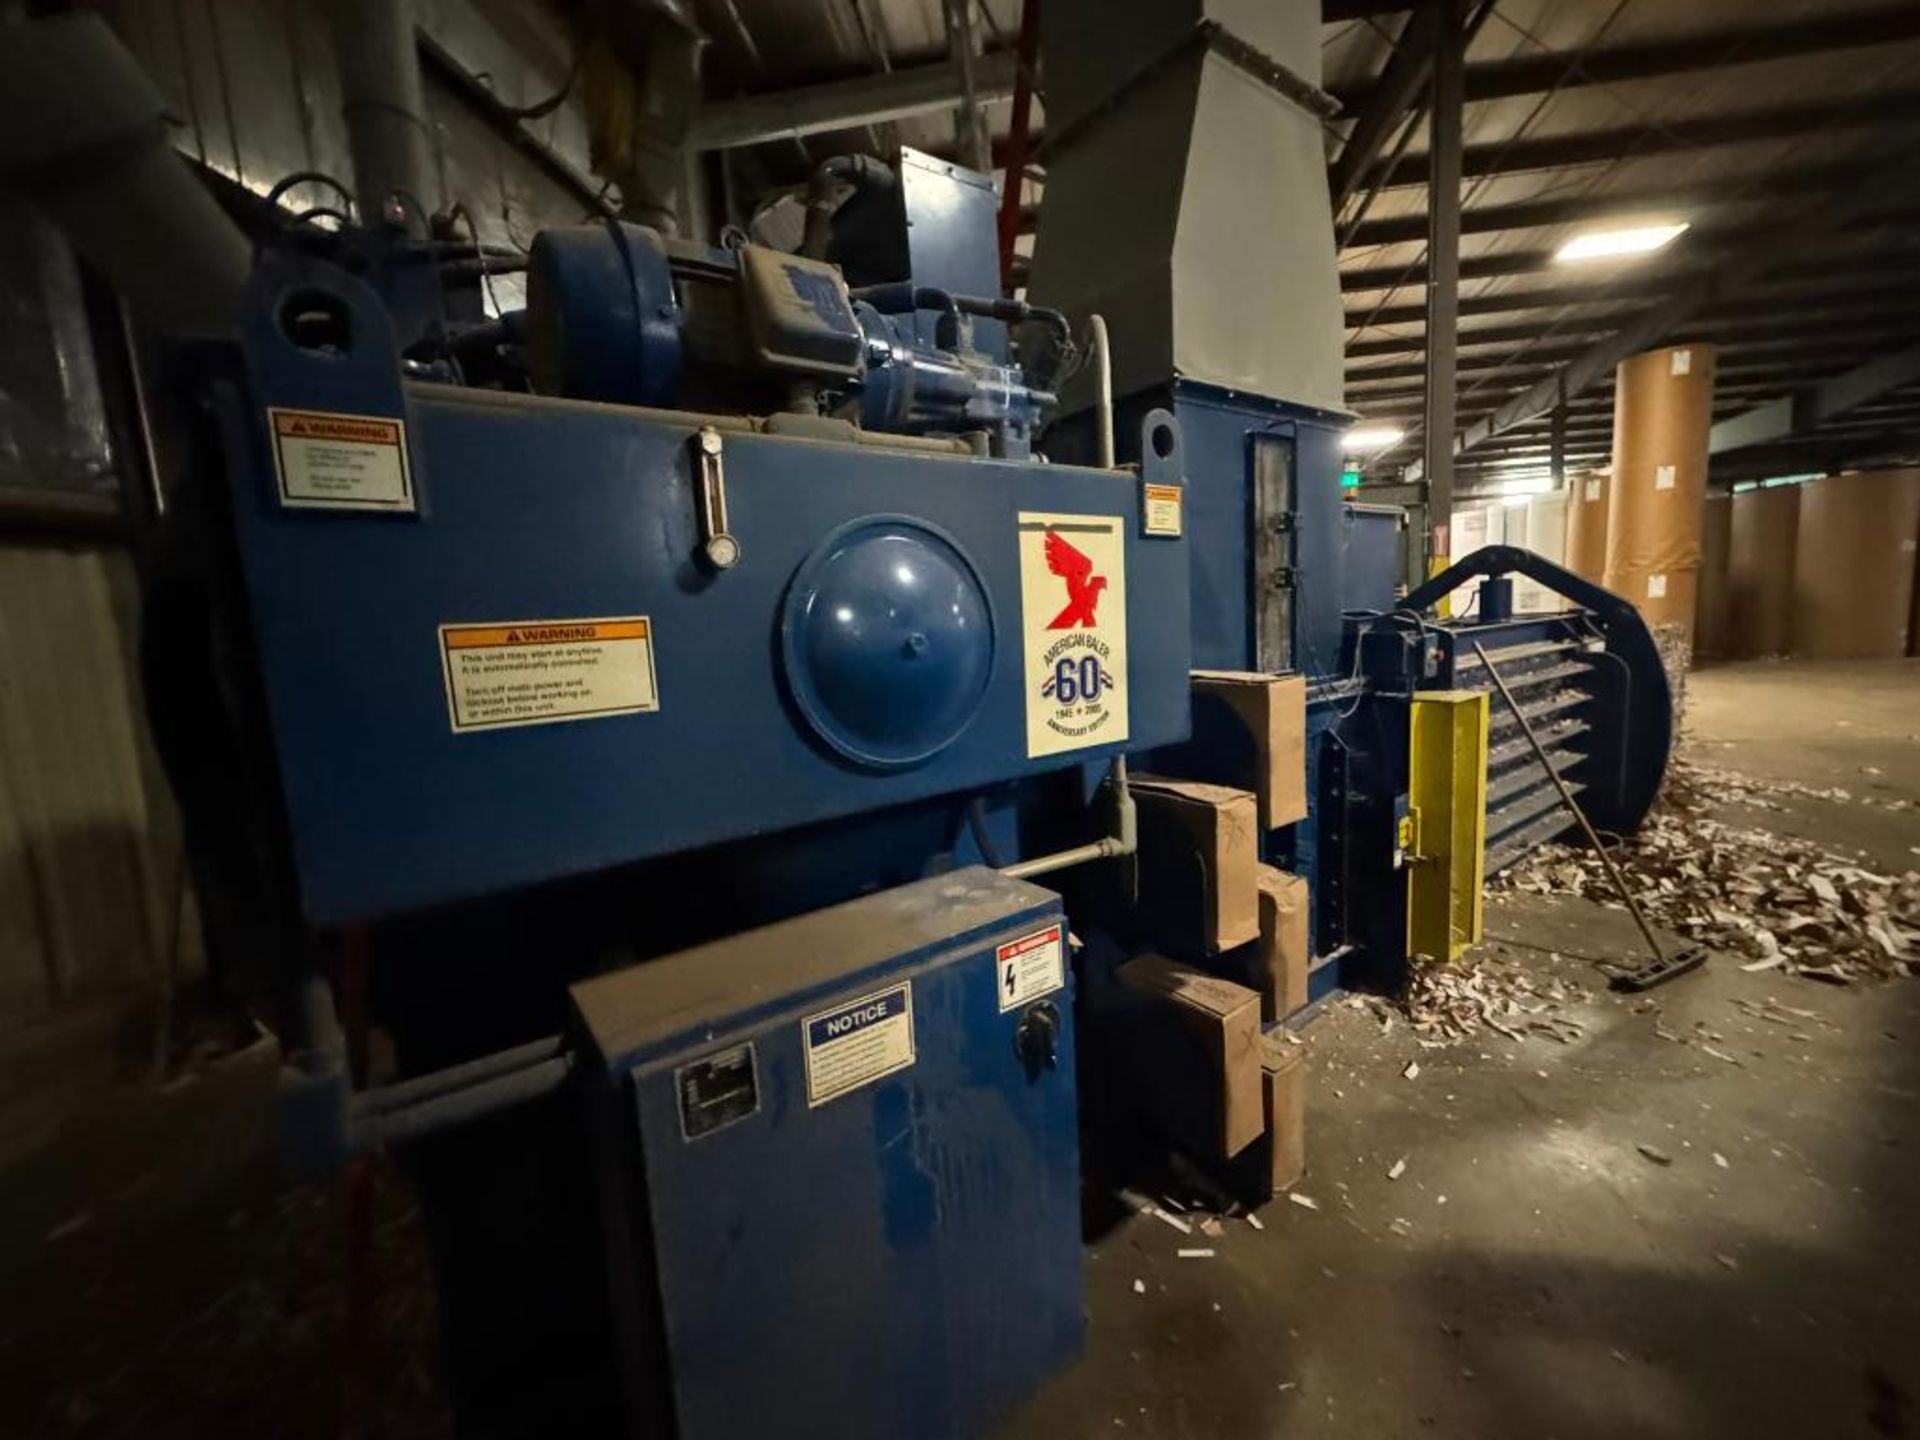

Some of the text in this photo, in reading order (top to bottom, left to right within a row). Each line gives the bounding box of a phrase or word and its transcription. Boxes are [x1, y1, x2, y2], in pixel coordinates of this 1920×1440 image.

[523, 626, 597, 641] WARNING
[461, 653, 482, 662] This
[485, 652, 505, 661] unit
[507, 652, 527, 661] may
[1043, 633, 1110, 668] AMERICAN BALER
[1056, 655, 1099, 704] 60
[491, 685, 505, 696] off
[534, 682, 563, 692] power
[514, 703, 533, 713] this
[827, 1001, 888, 1036] NOTICE
